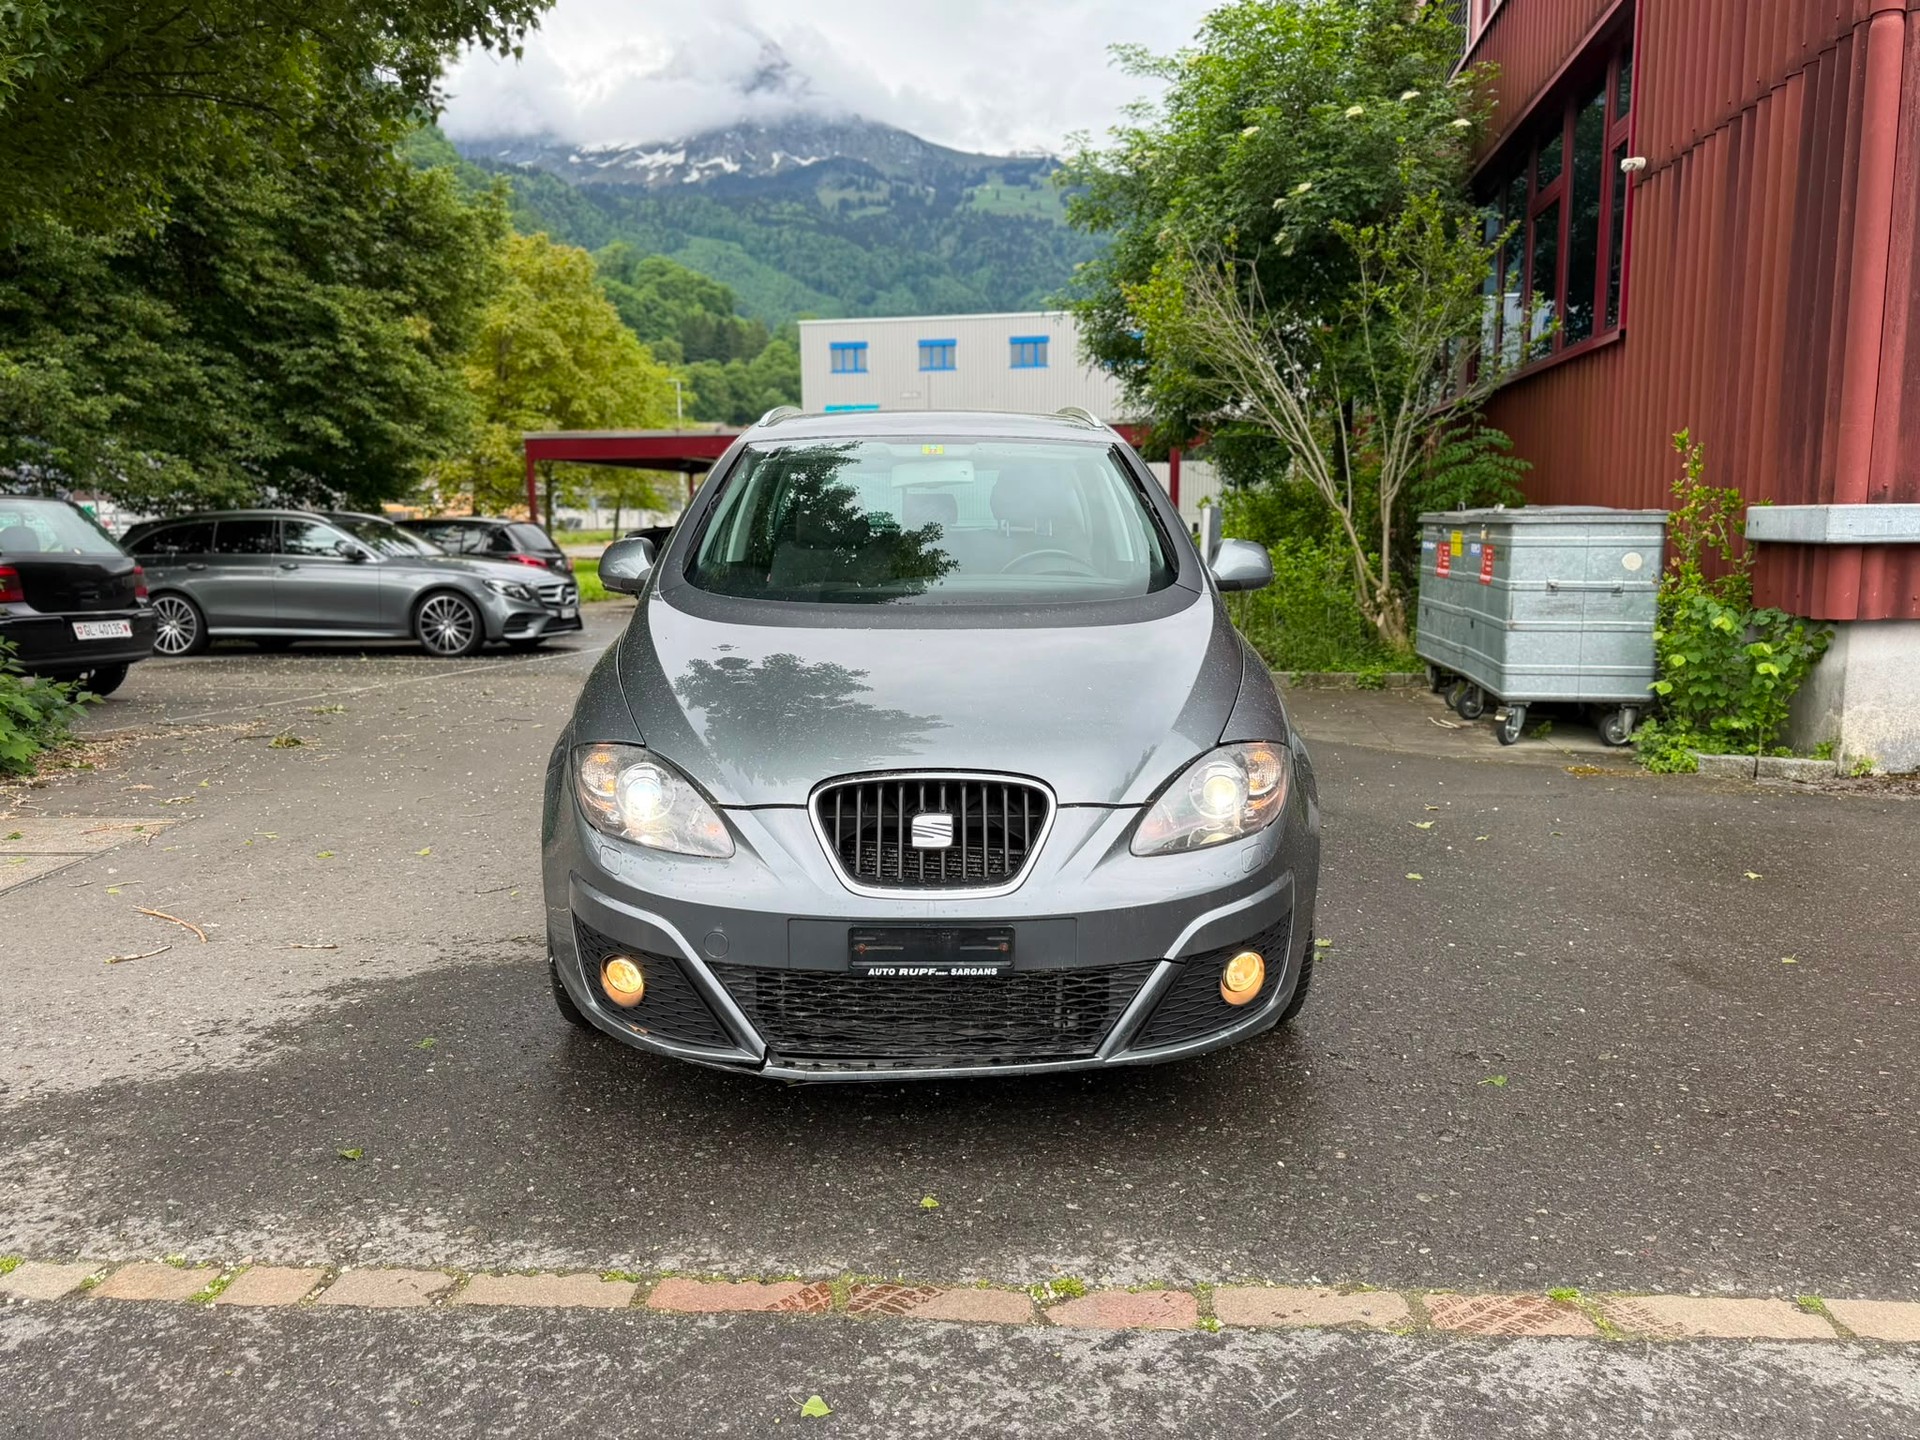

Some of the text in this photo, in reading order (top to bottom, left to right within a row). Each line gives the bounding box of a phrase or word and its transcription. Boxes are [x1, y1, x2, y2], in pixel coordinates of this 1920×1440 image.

[868, 968, 896, 976] AUTO
[898, 968, 937, 976] RUPF
[950, 967, 998, 976] SARGANS
